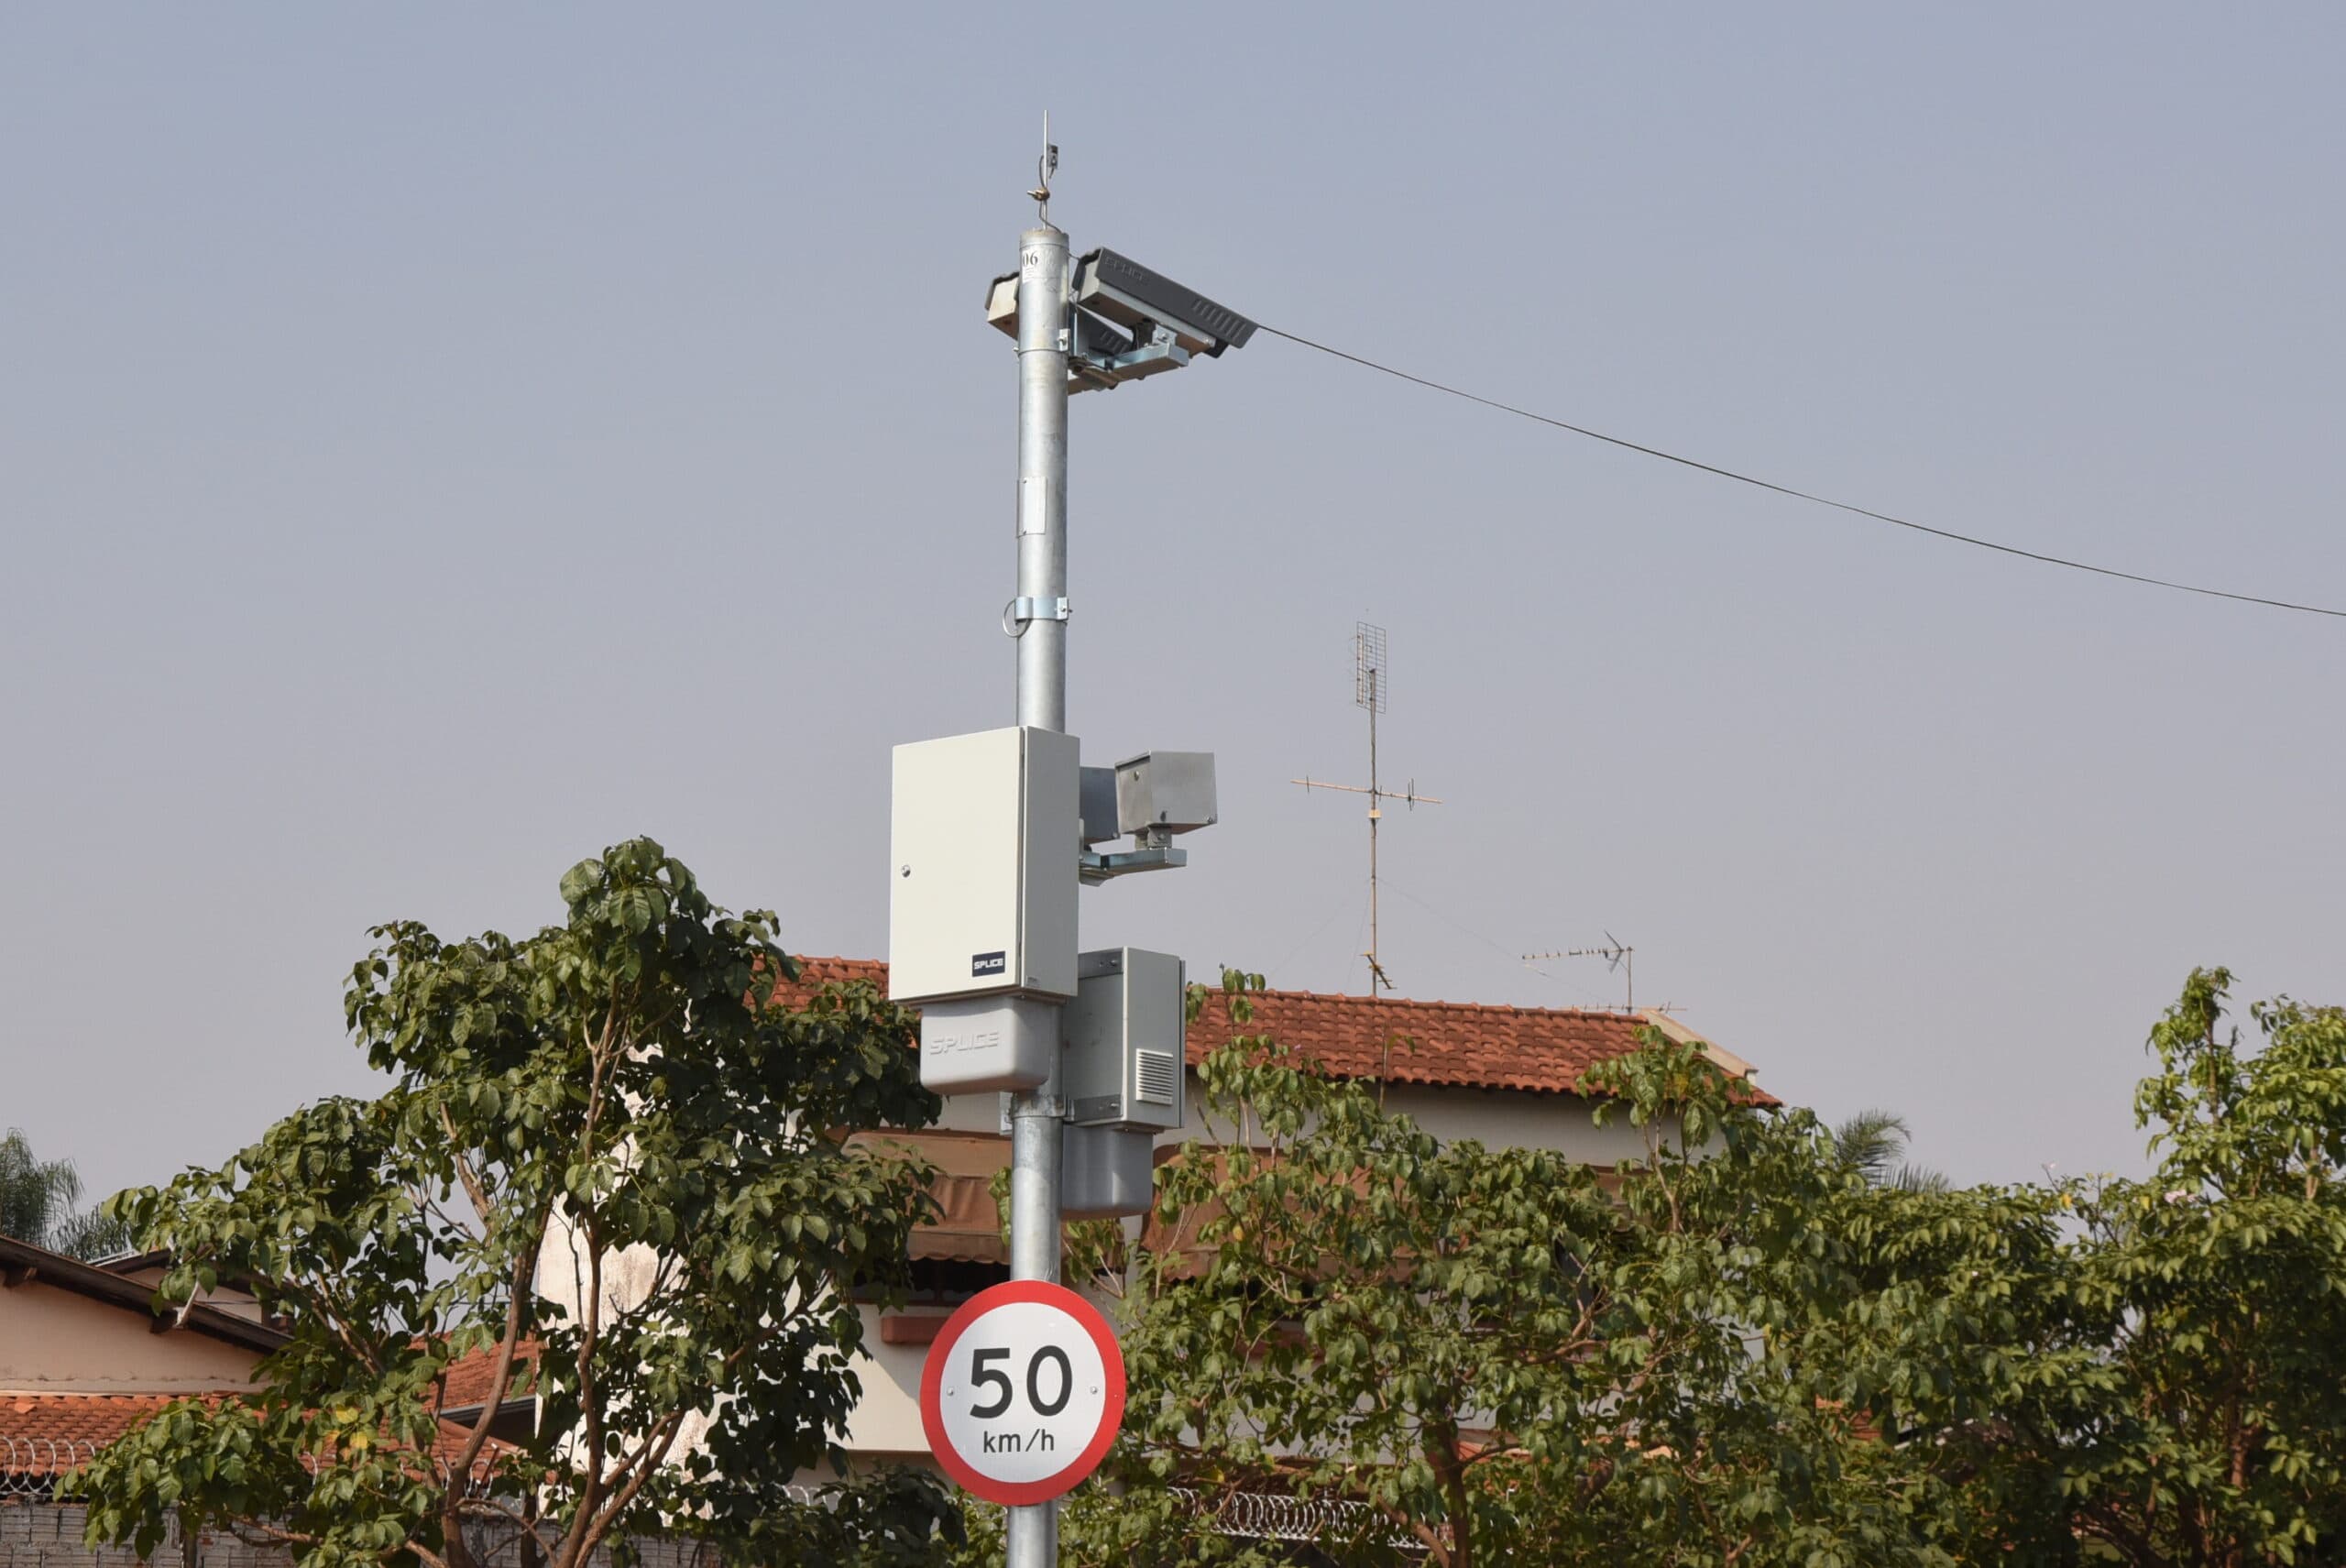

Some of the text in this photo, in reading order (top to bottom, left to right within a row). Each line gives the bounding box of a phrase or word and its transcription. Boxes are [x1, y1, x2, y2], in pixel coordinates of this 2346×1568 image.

[974, 958, 1004, 970] SPLICE
[929, 1030, 999, 1056] SPLICE
[970, 1344, 1073, 1420] 50
[983, 1429, 1055, 1453] km/h
